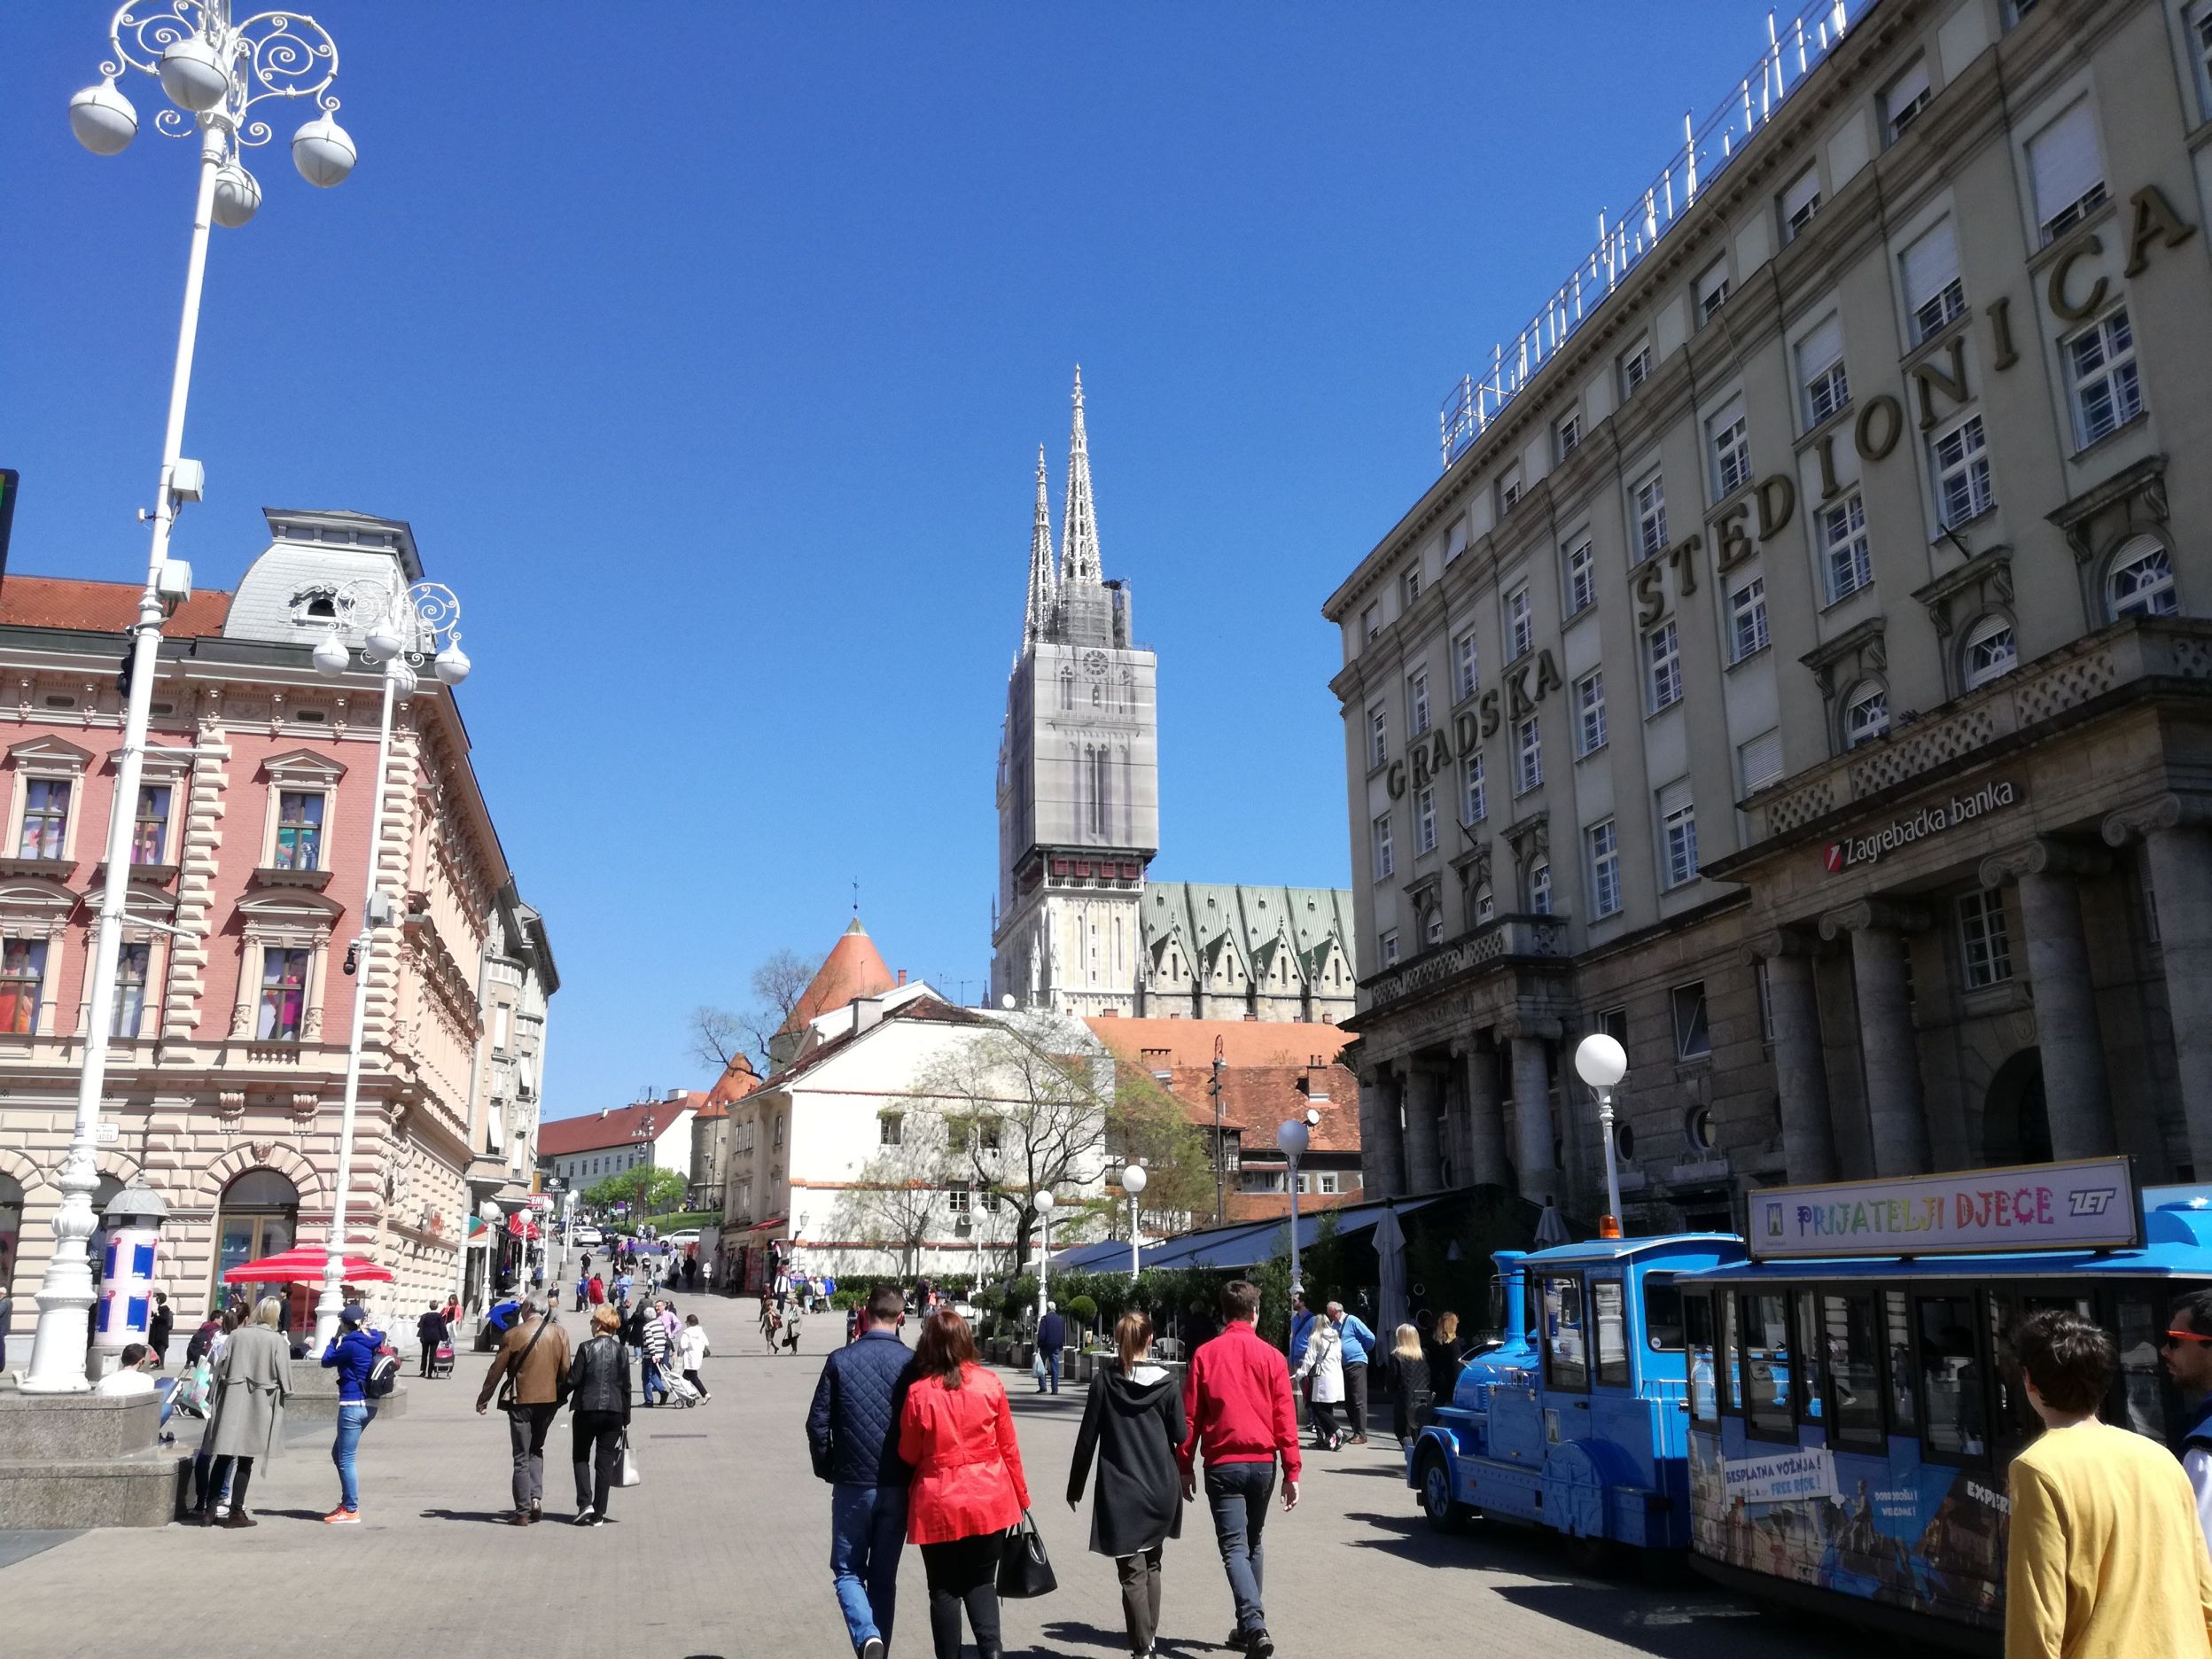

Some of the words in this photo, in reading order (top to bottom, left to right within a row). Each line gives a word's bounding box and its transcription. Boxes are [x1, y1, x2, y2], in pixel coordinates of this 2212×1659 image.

[1386, 649, 1562, 800] GRADSKA
[1636, 183, 2197, 627] ŠTEDIONICA
[1844, 807, 1946, 866] Zagrebačka
[1951, 781, 2014, 824] banka
[1797, 1196, 1945, 1237] PRIJATELJI
[1956, 1187, 2054, 1230] DJECE
[2068, 1188, 2117, 1218] ZET
[1725, 1464, 1775, 1484] BESPLATNA
[1771, 1480, 1792, 1496] FREE
